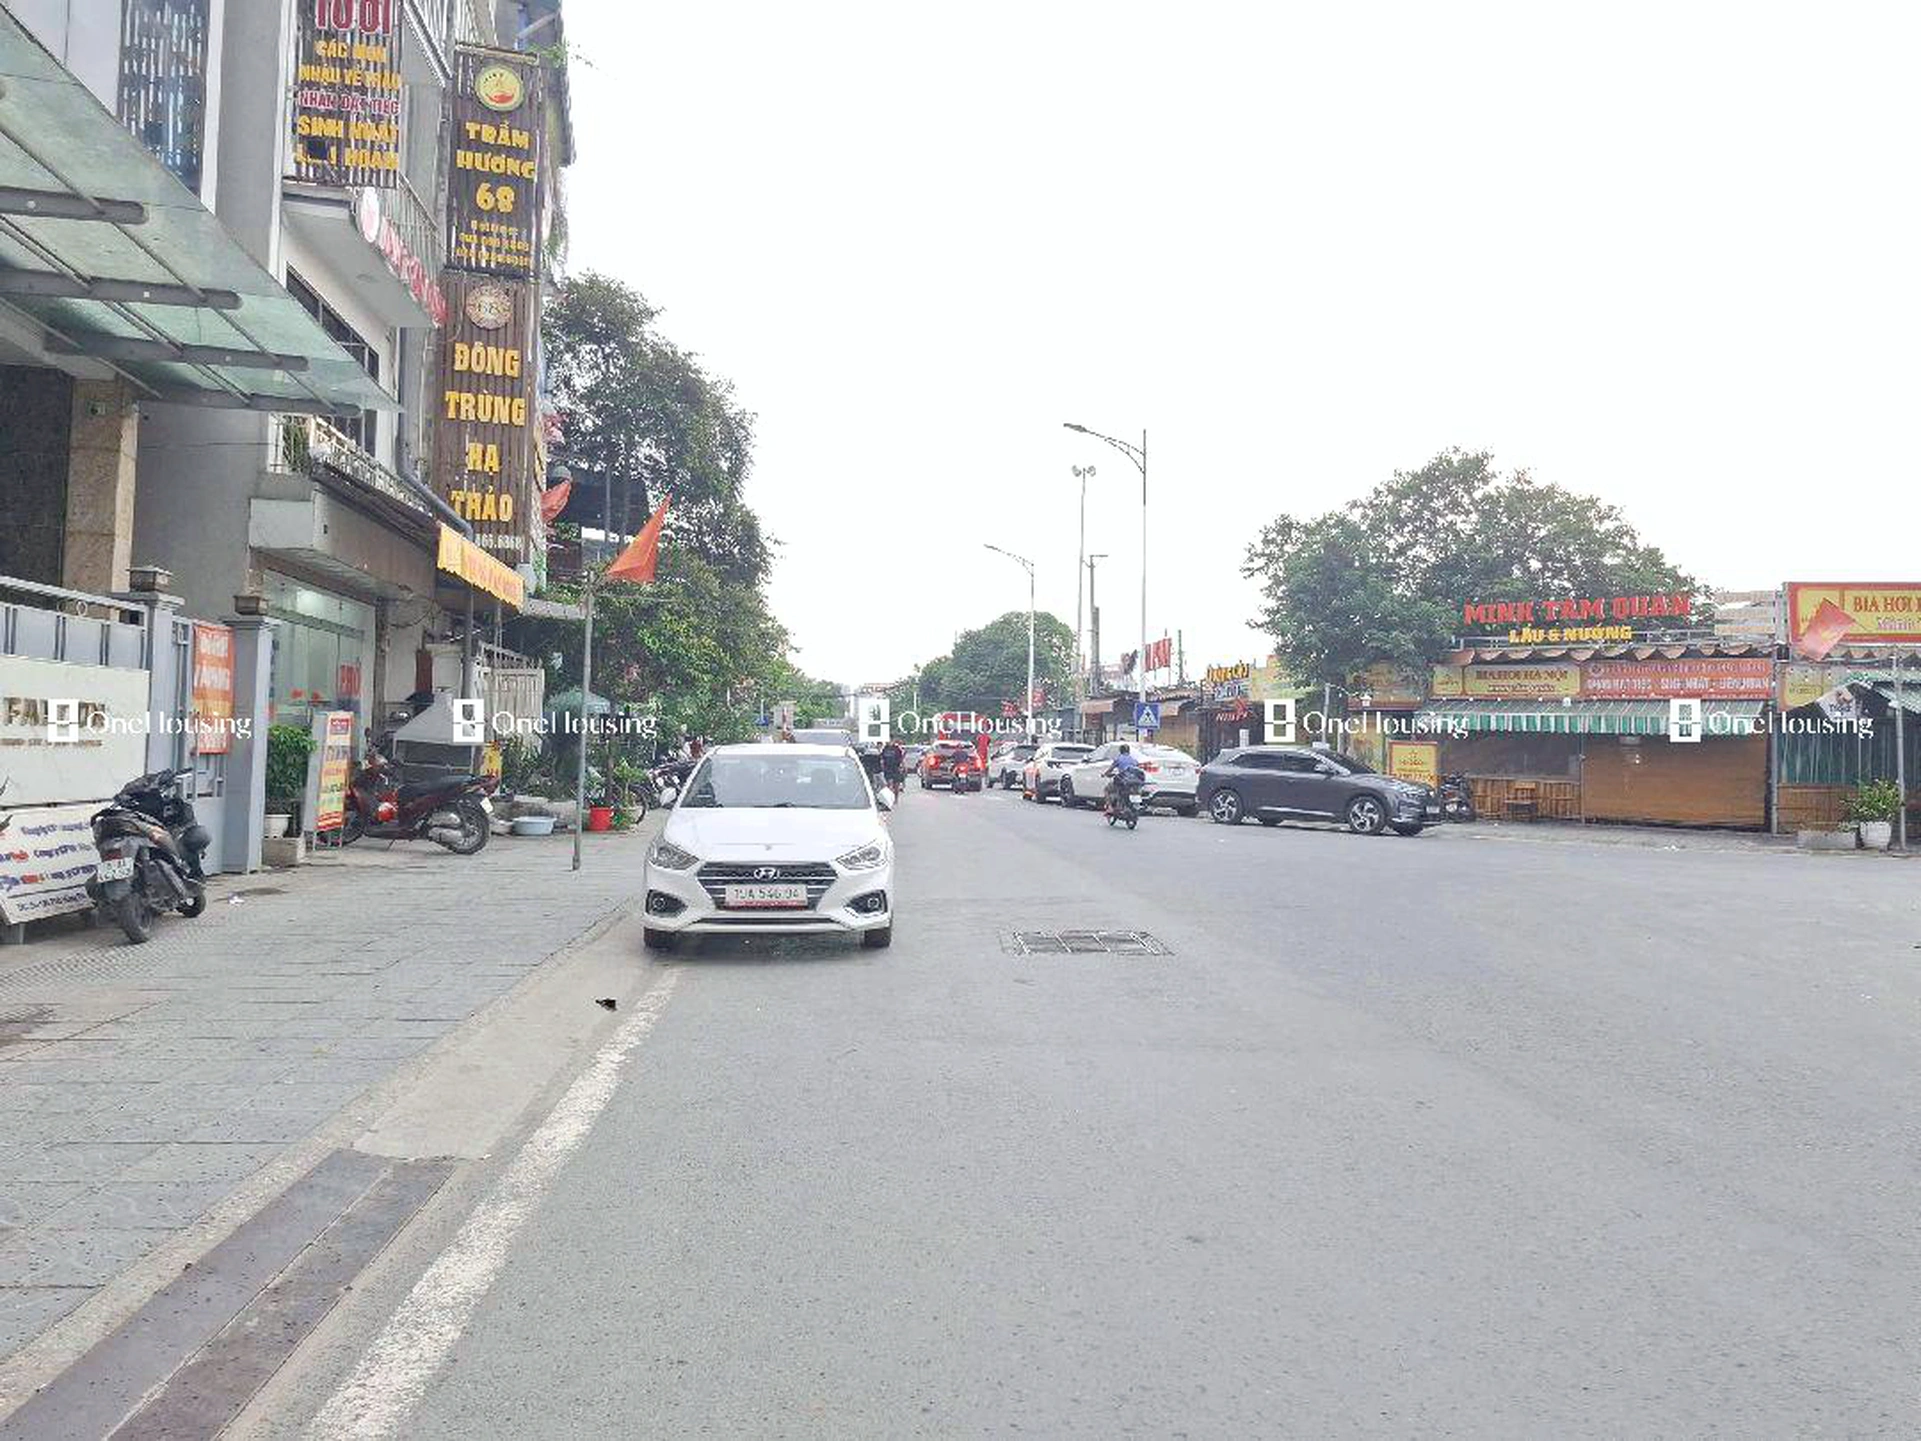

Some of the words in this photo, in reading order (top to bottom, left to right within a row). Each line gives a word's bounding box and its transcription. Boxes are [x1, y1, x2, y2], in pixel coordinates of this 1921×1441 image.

[456, 150, 535, 178] HƯƠNG
[476, 182, 515, 212] 68
[454, 341, 521, 377] ĐÔNG
[445, 388, 526, 426] TRÙNG
[465, 443, 500, 476] HẠ
[451, 485, 513, 522] THẢO
[1463, 600, 1534, 625] MINH
[1853, 596, 1881, 612] BIA
